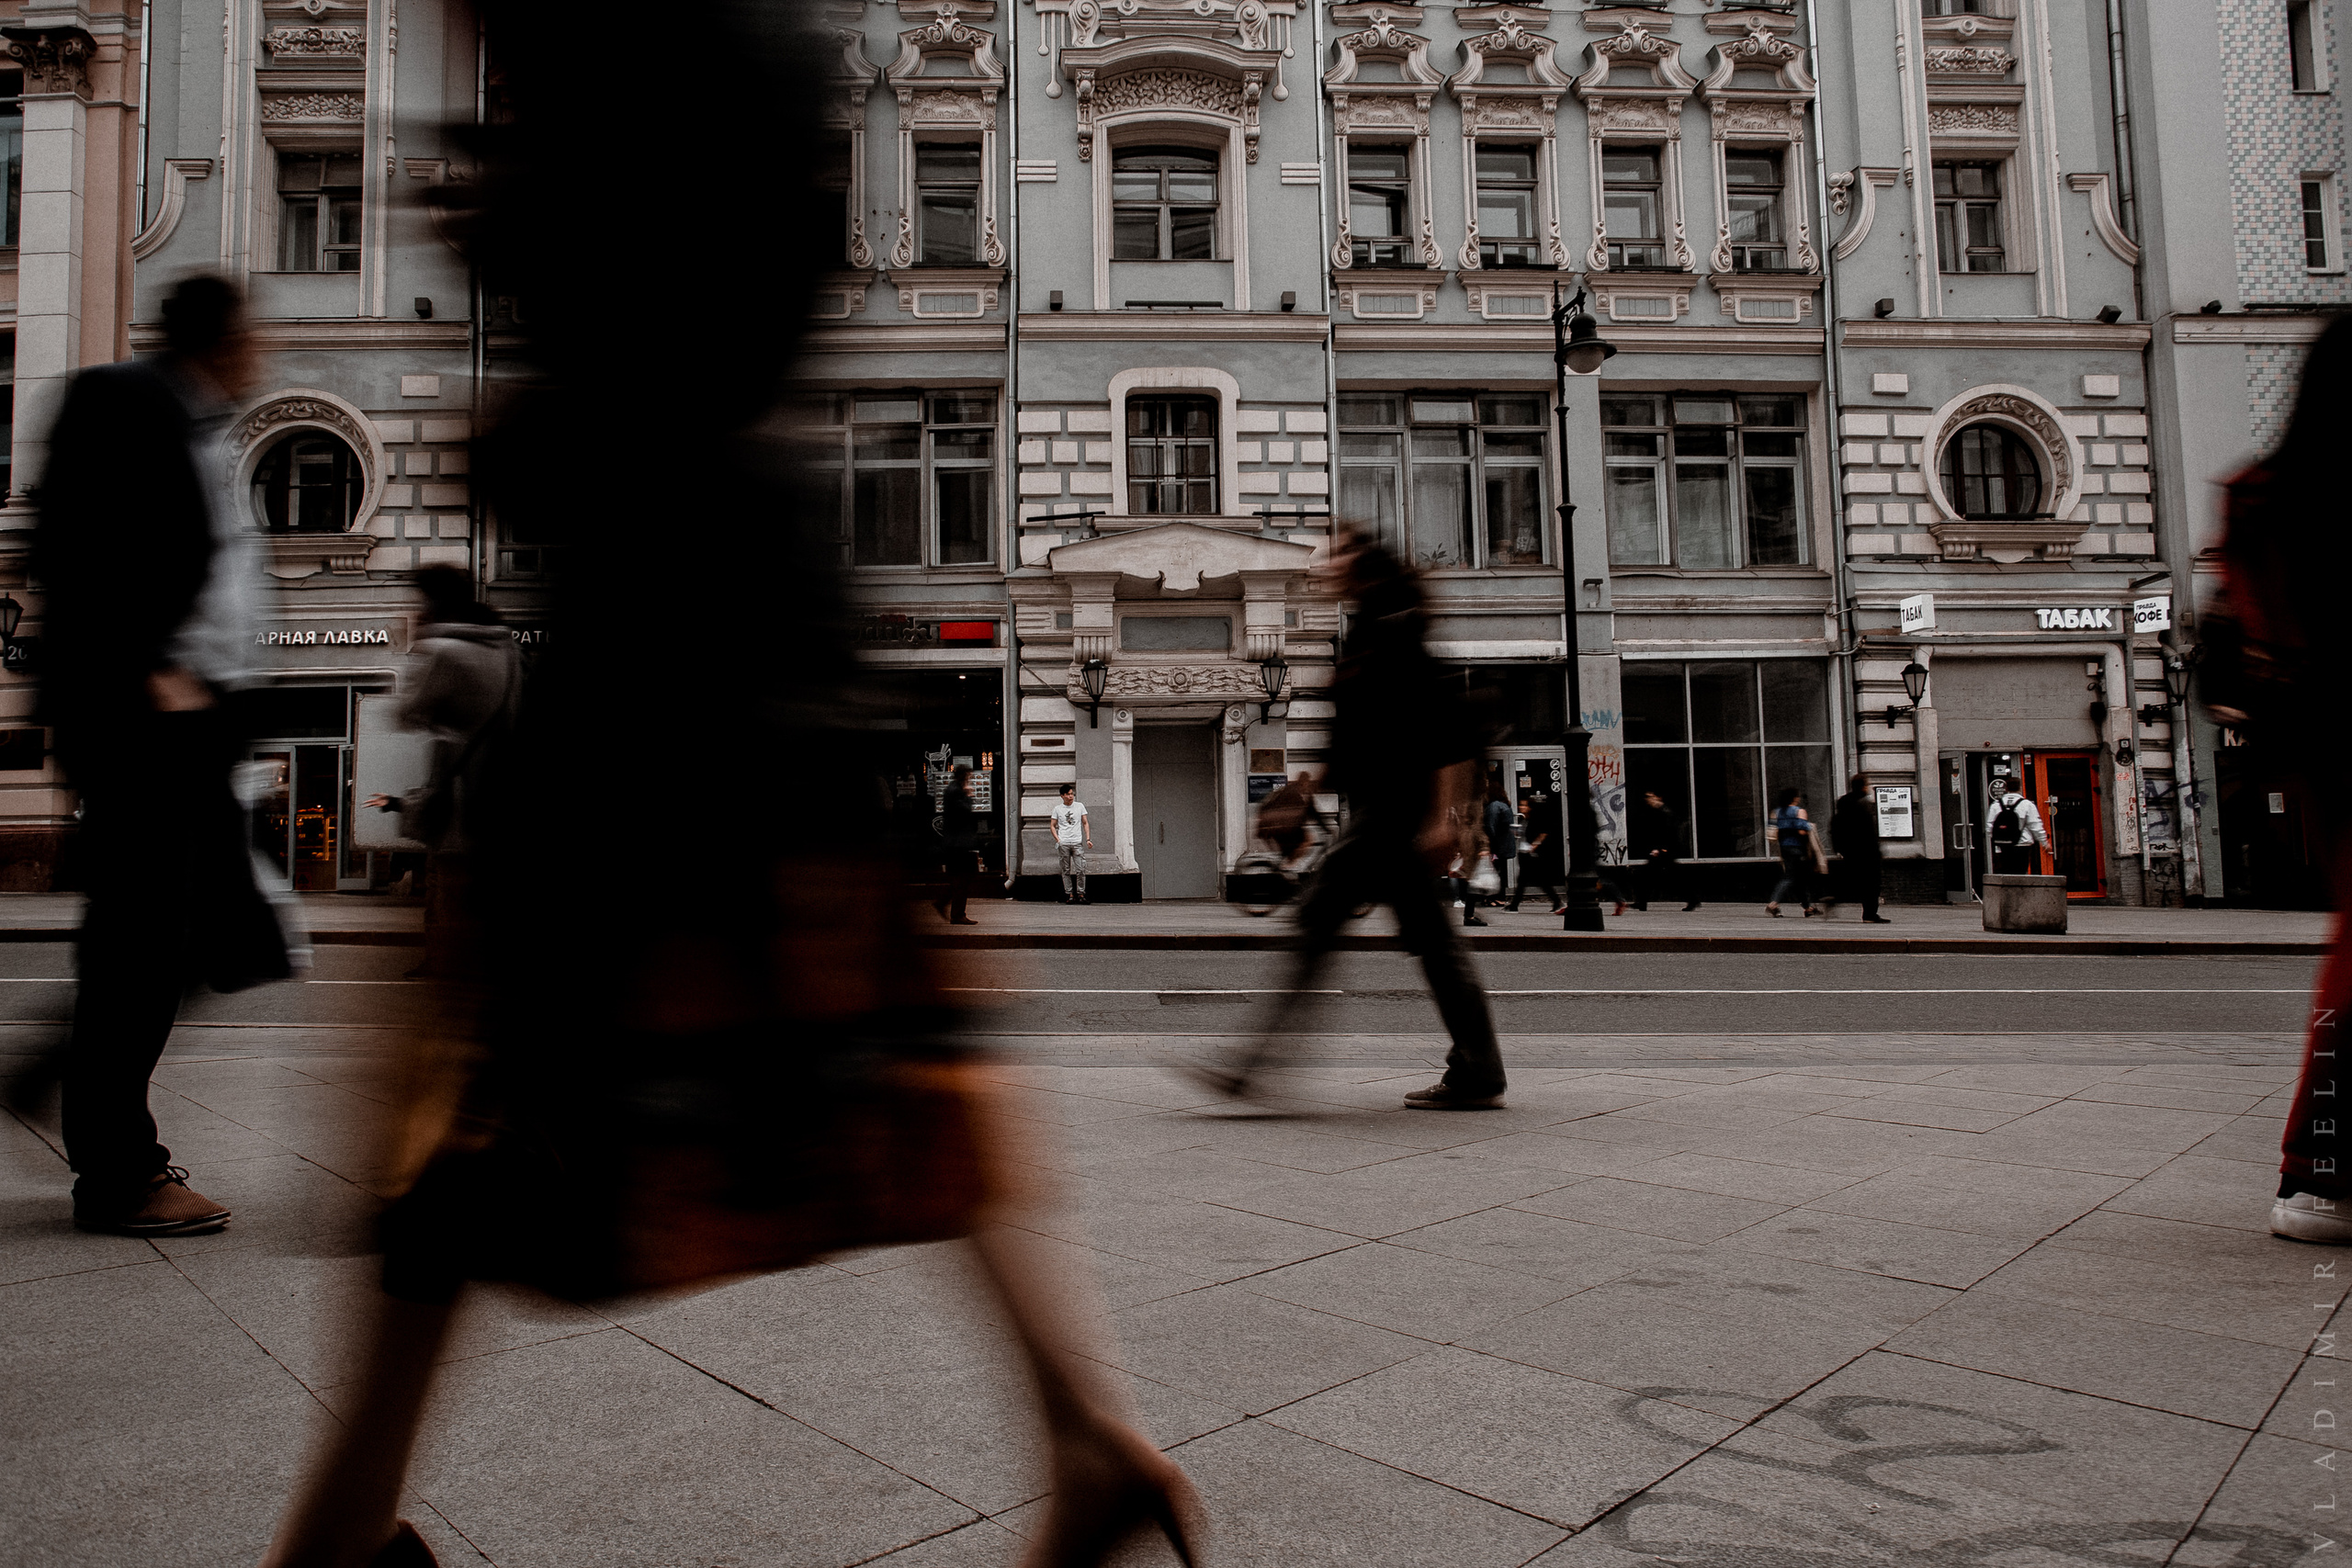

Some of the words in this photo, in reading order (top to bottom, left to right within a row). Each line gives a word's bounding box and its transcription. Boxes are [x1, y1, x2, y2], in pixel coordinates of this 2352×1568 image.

[1901, 604, 1923, 624] ТАБАК
[2036, 608, 2112, 629] ТАБАК
[323, 629, 390, 644] ЛАВКА
